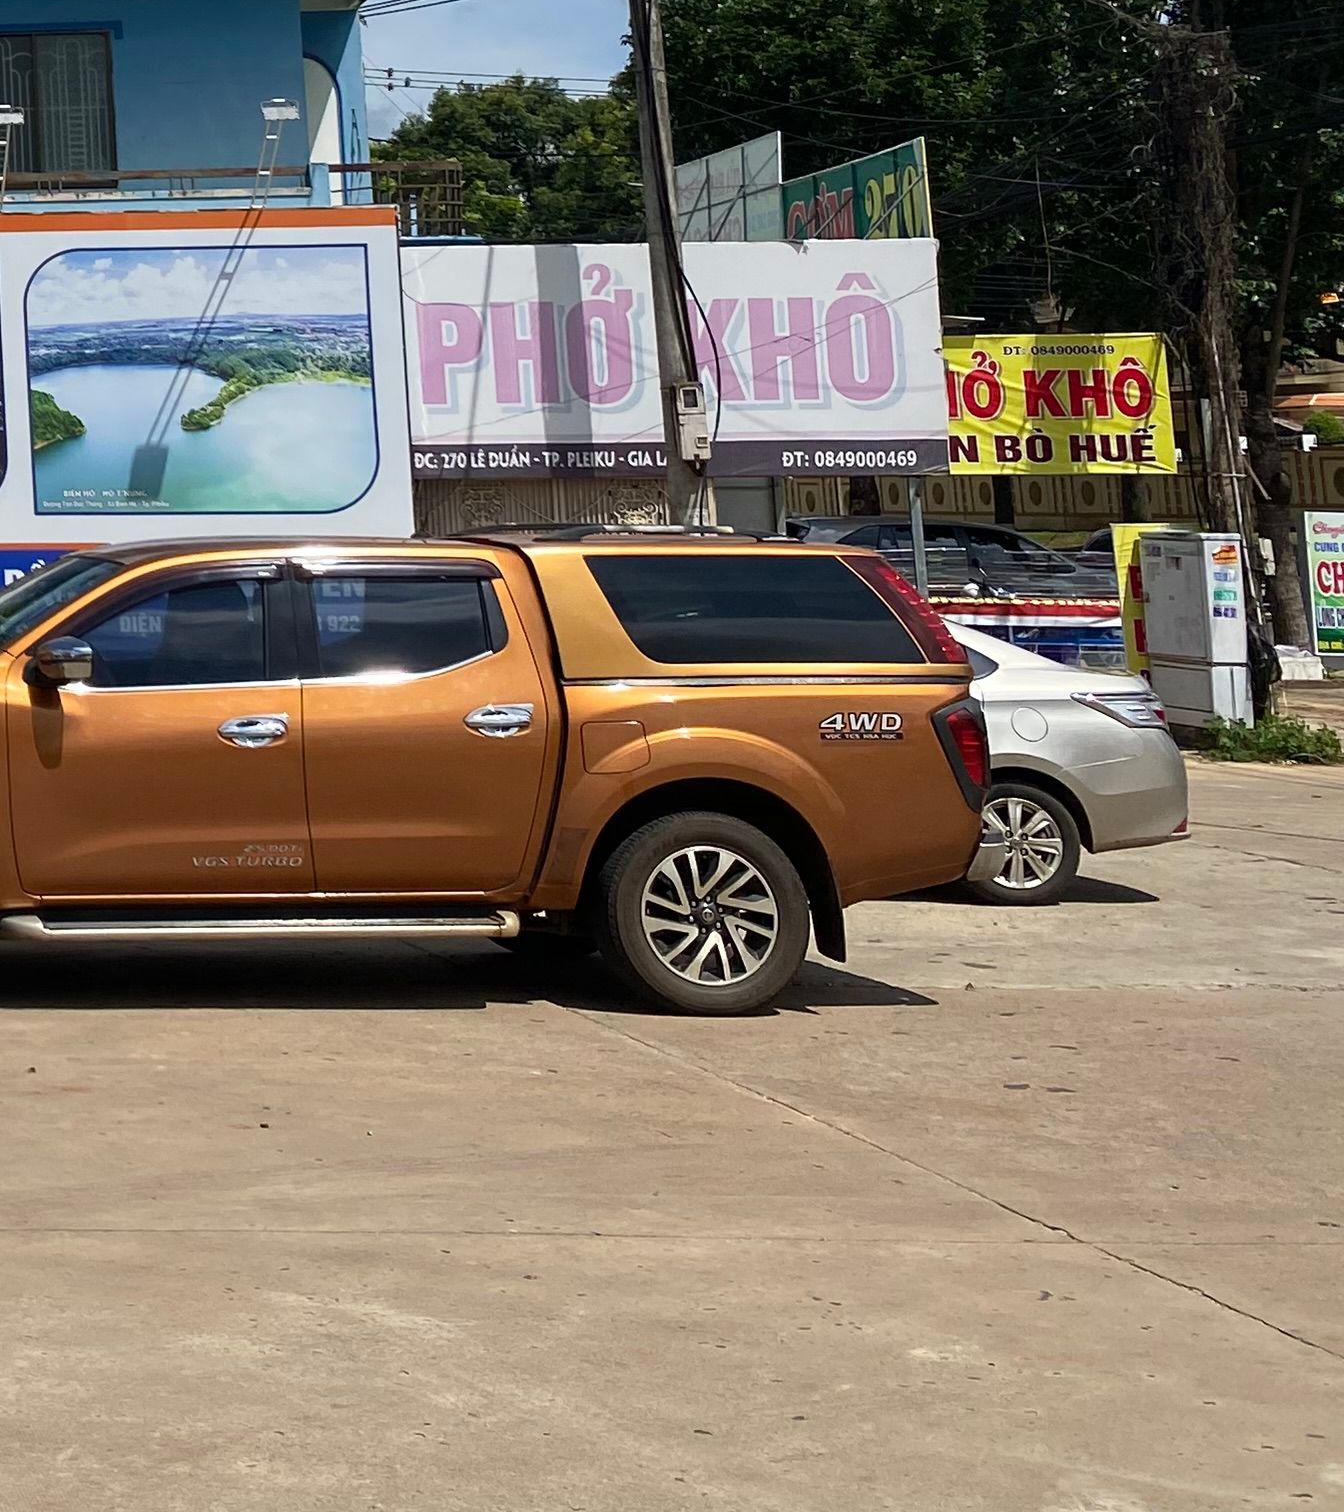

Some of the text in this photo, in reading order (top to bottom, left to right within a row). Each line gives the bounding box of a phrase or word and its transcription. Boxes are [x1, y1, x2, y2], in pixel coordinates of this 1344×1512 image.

[416, 264, 634, 405] PHỞ
[687, 272, 896, 401] KHÔ
[1022, 356, 1154, 418] KHÔ
[440, 451, 467, 469] 270
[469, 448, 487, 469] LÊ
[542, 450, 565, 469] TP.
[567, 450, 616, 469] PLEIKU
[627, 449, 653, 468] GIA
[994, 427, 1053, 463] BÒ
[1069, 424, 1157, 463] HUẾ
[782, 450, 918, 468] ĐT: 0849000469
[819, 712, 903, 731] 4WD
[235, 855, 304, 867] TURBO
